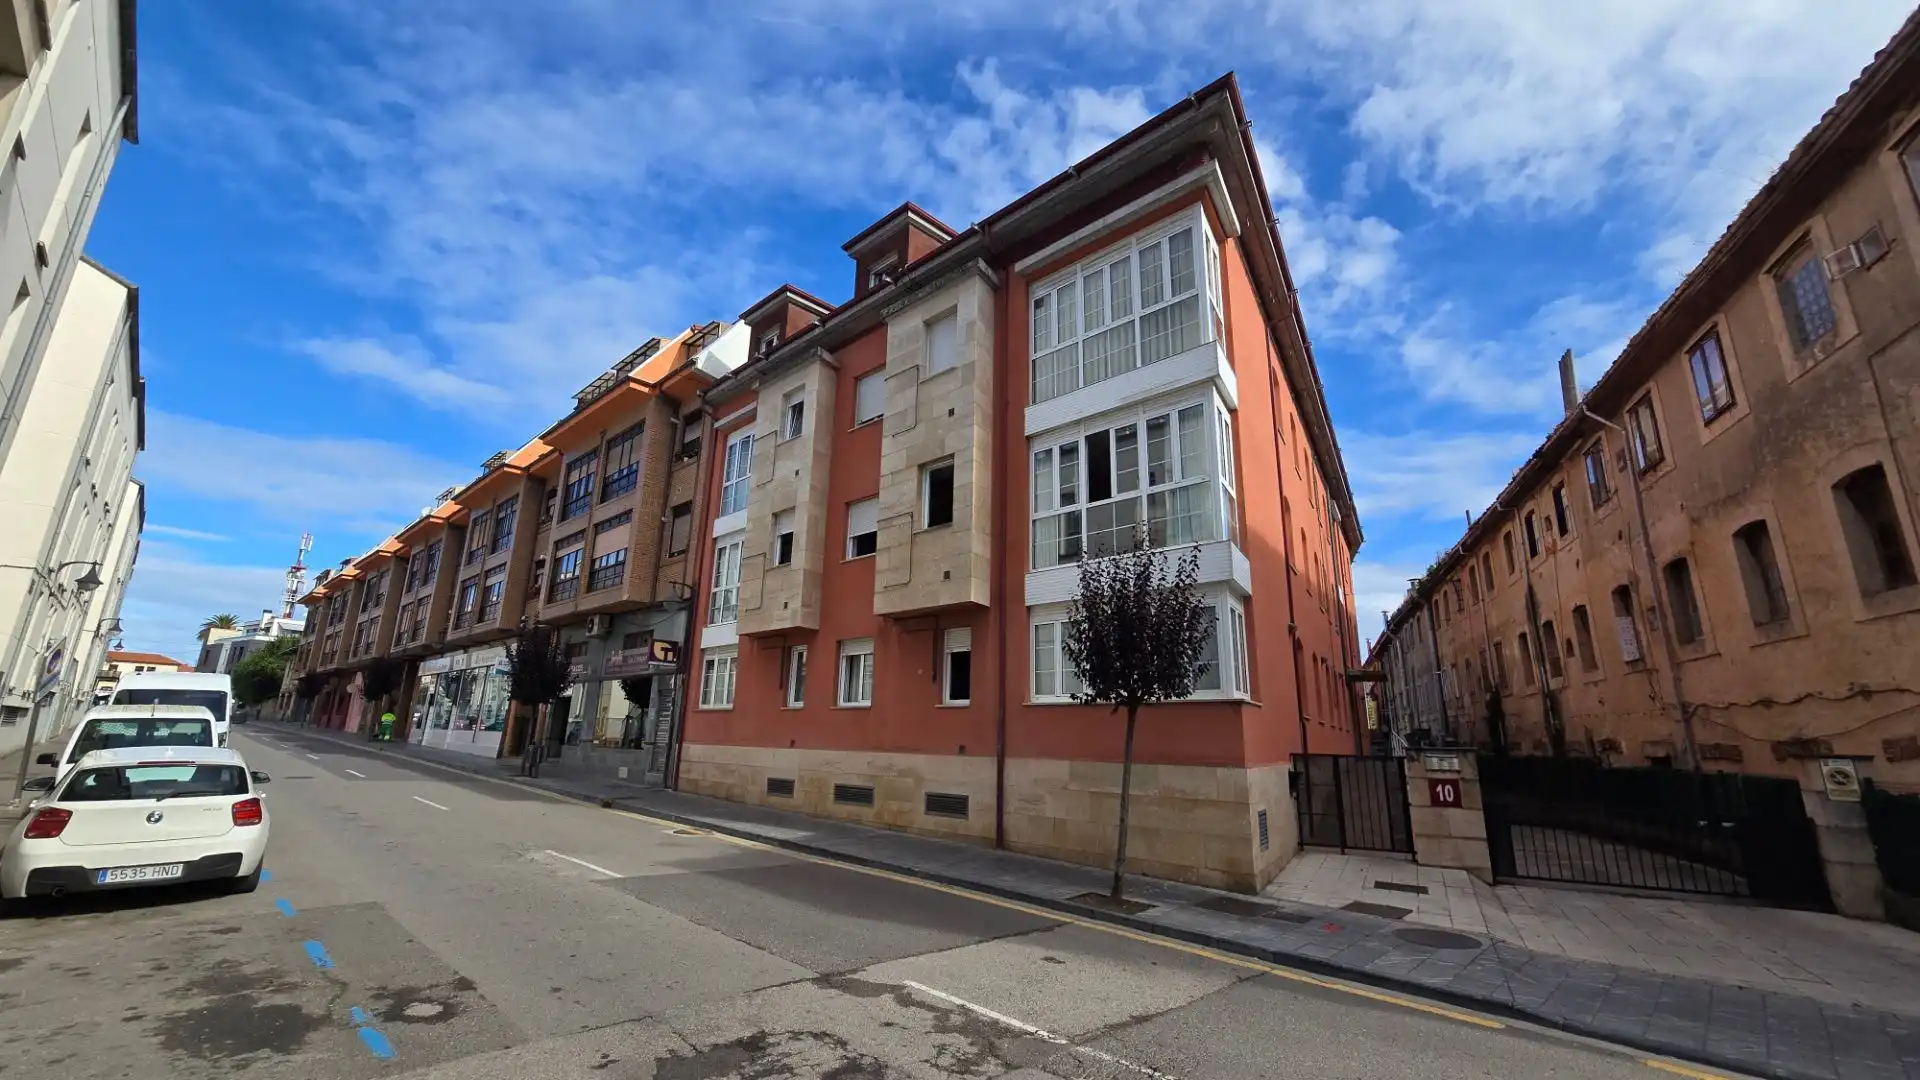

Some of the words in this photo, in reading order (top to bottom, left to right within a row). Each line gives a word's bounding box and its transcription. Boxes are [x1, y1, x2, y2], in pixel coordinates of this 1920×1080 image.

[1436, 783, 1454, 802] 10
[109, 867, 147, 880] 5535
[152, 865, 180, 878] HND
